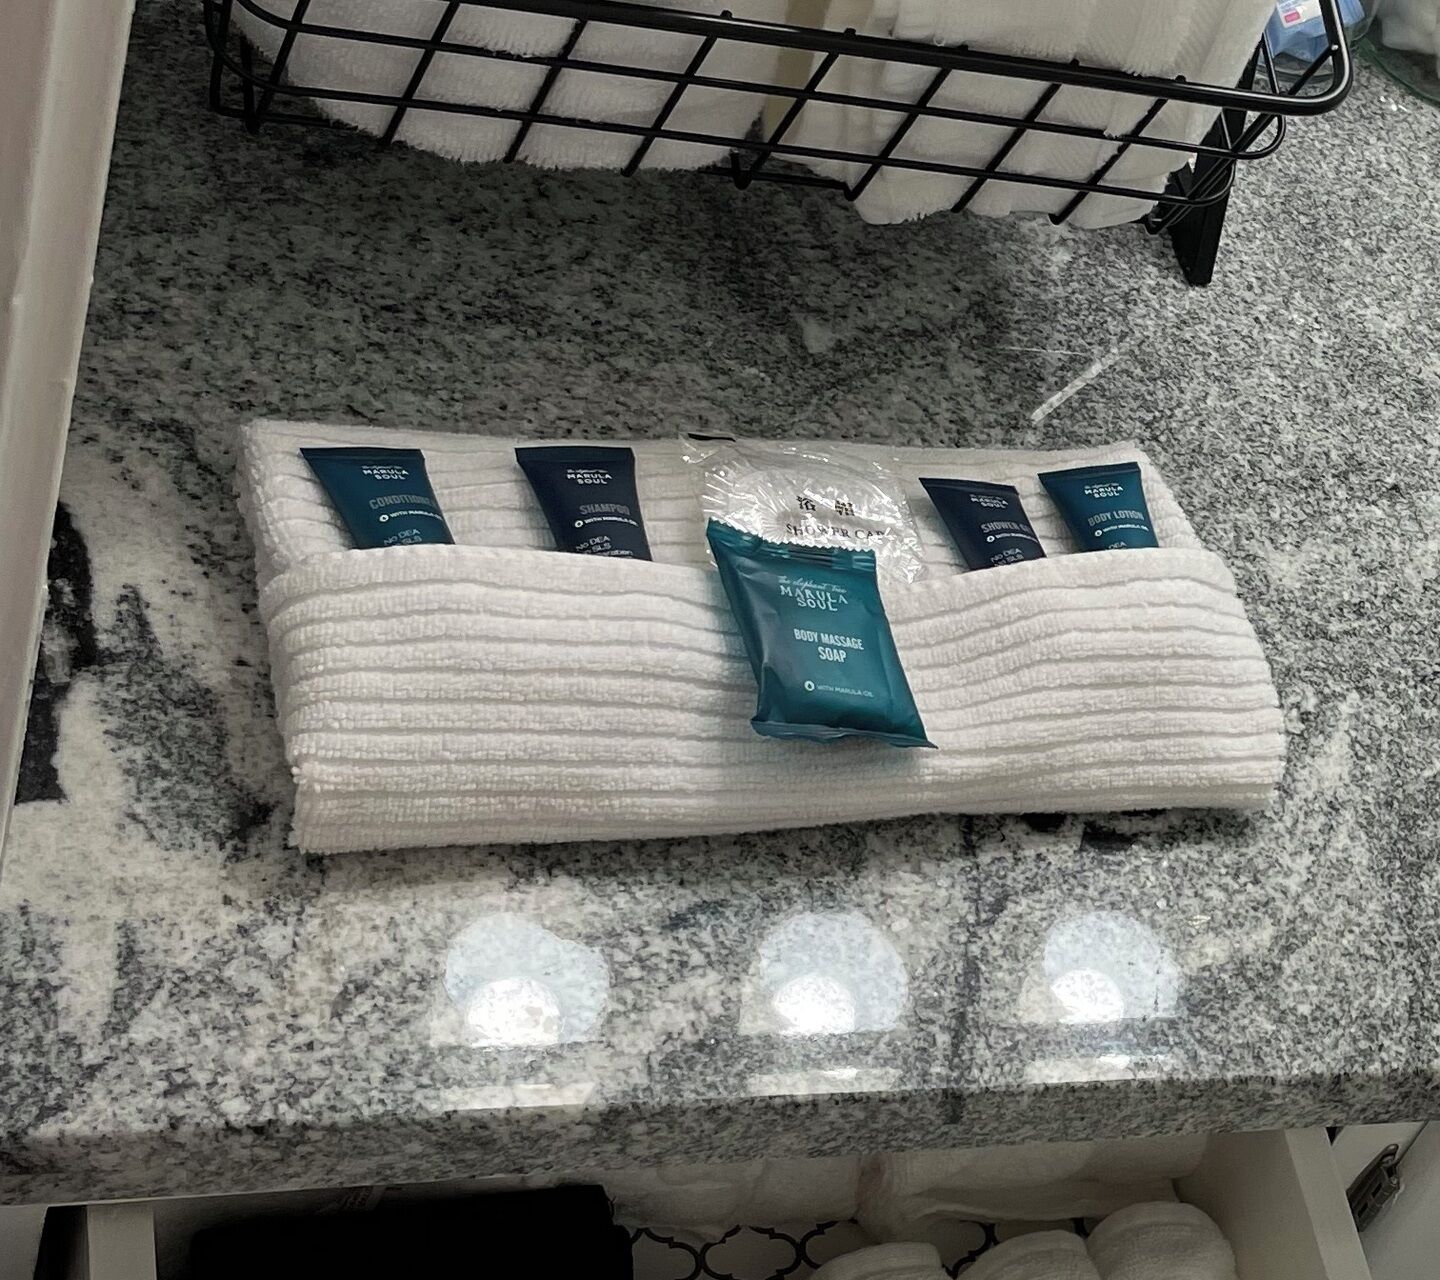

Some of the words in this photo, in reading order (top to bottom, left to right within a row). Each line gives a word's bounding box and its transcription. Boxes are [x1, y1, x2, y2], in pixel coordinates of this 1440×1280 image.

[579, 503, 630, 516] SHAMPOO
[980, 521, 1020, 533] SHOWER
[1087, 512, 1112, 527] BODY
[1113, 510, 1145, 521] LOTION
[780, 585, 849, 605] MARULA
[797, 597, 838, 612] SOUL
[793, 628, 819, 643] BODY
[820, 632, 865, 651] MASSAGE
[817, 646, 847, 663] SOAP
